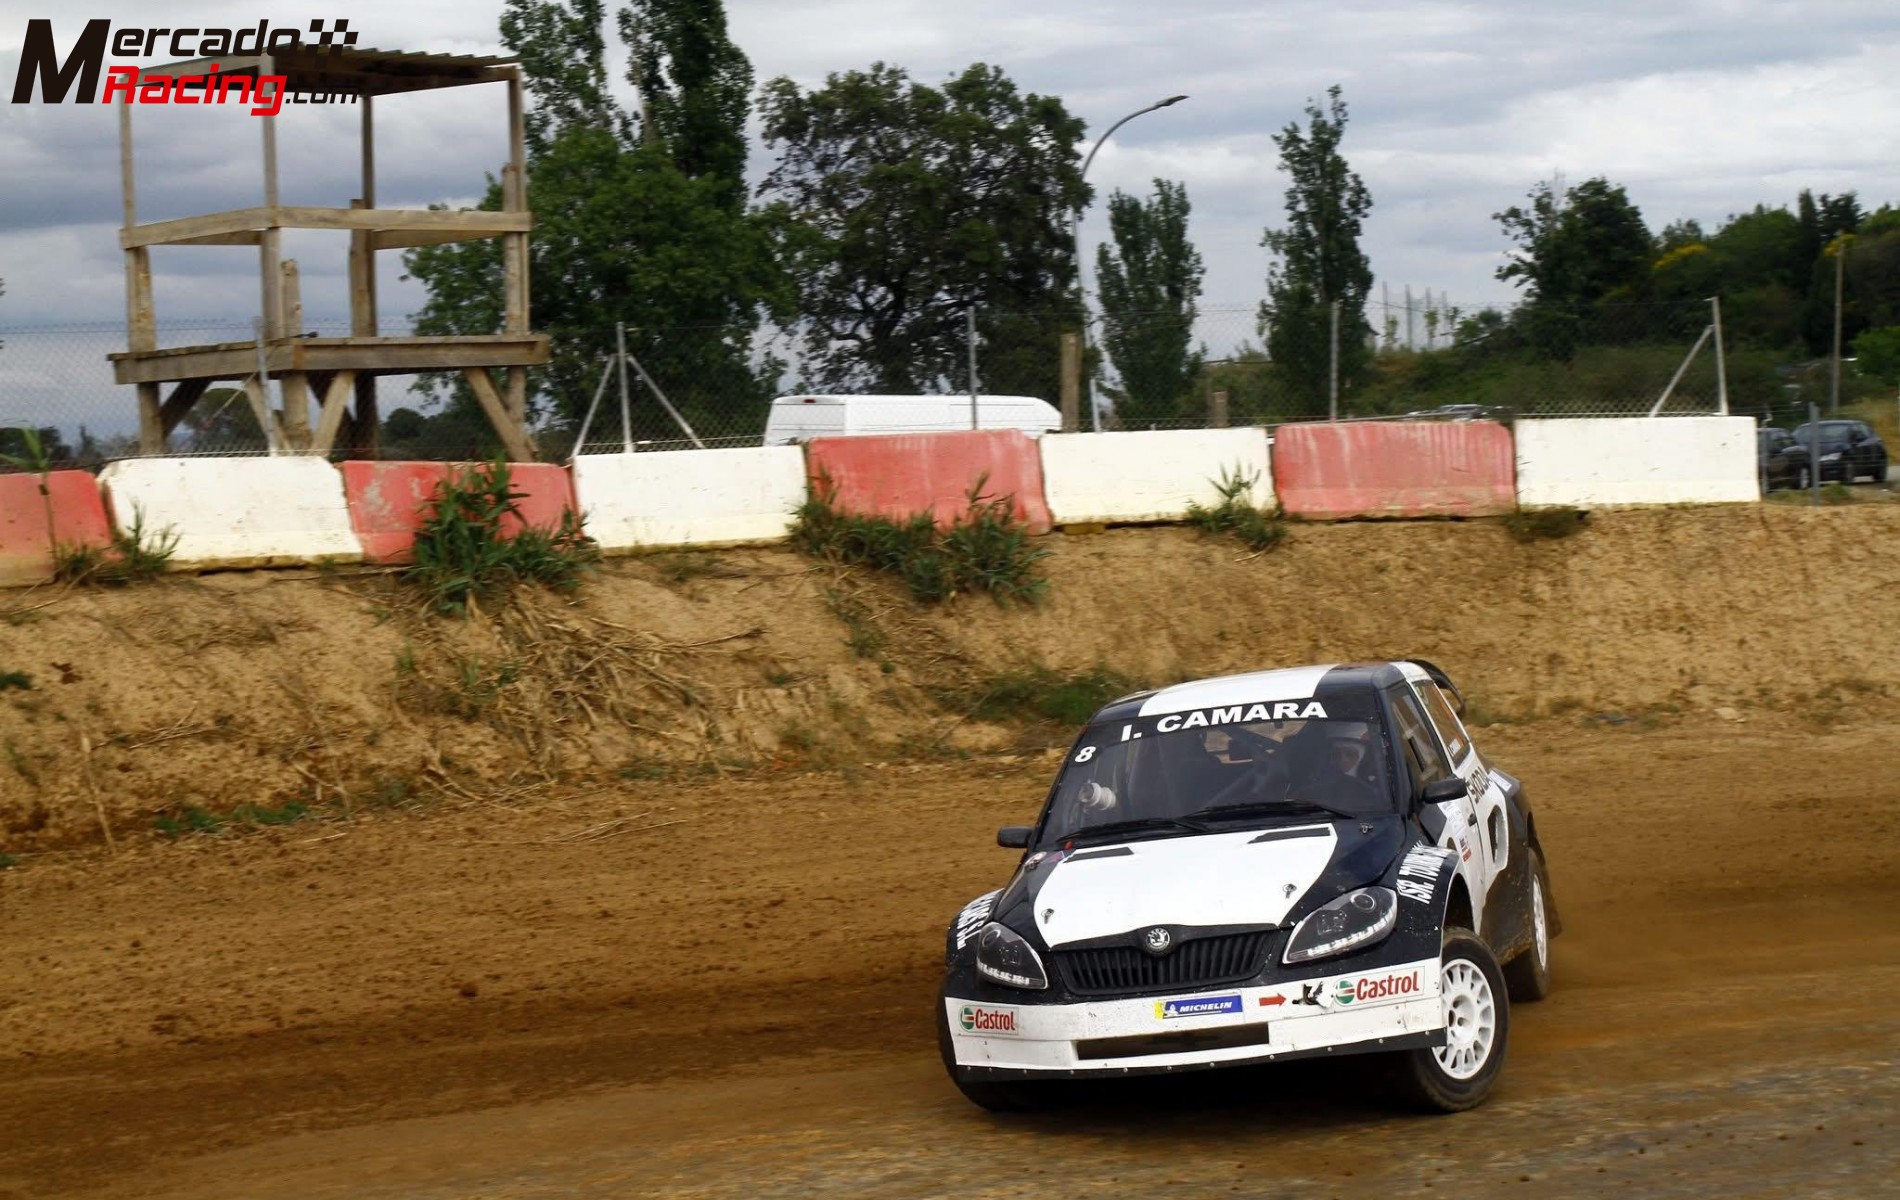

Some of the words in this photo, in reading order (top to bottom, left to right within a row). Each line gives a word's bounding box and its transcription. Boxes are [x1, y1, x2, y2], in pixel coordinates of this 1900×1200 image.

[1121, 724, 1142, 742] I.
[1156, 701, 1328, 733] CAMARA
[1075, 746, 1096, 763] 8
[1356, 971, 1420, 1001] Castrol
[1180, 1001, 1233, 1013] MICHELIN
[975, 1008, 1016, 1031] Castrol
